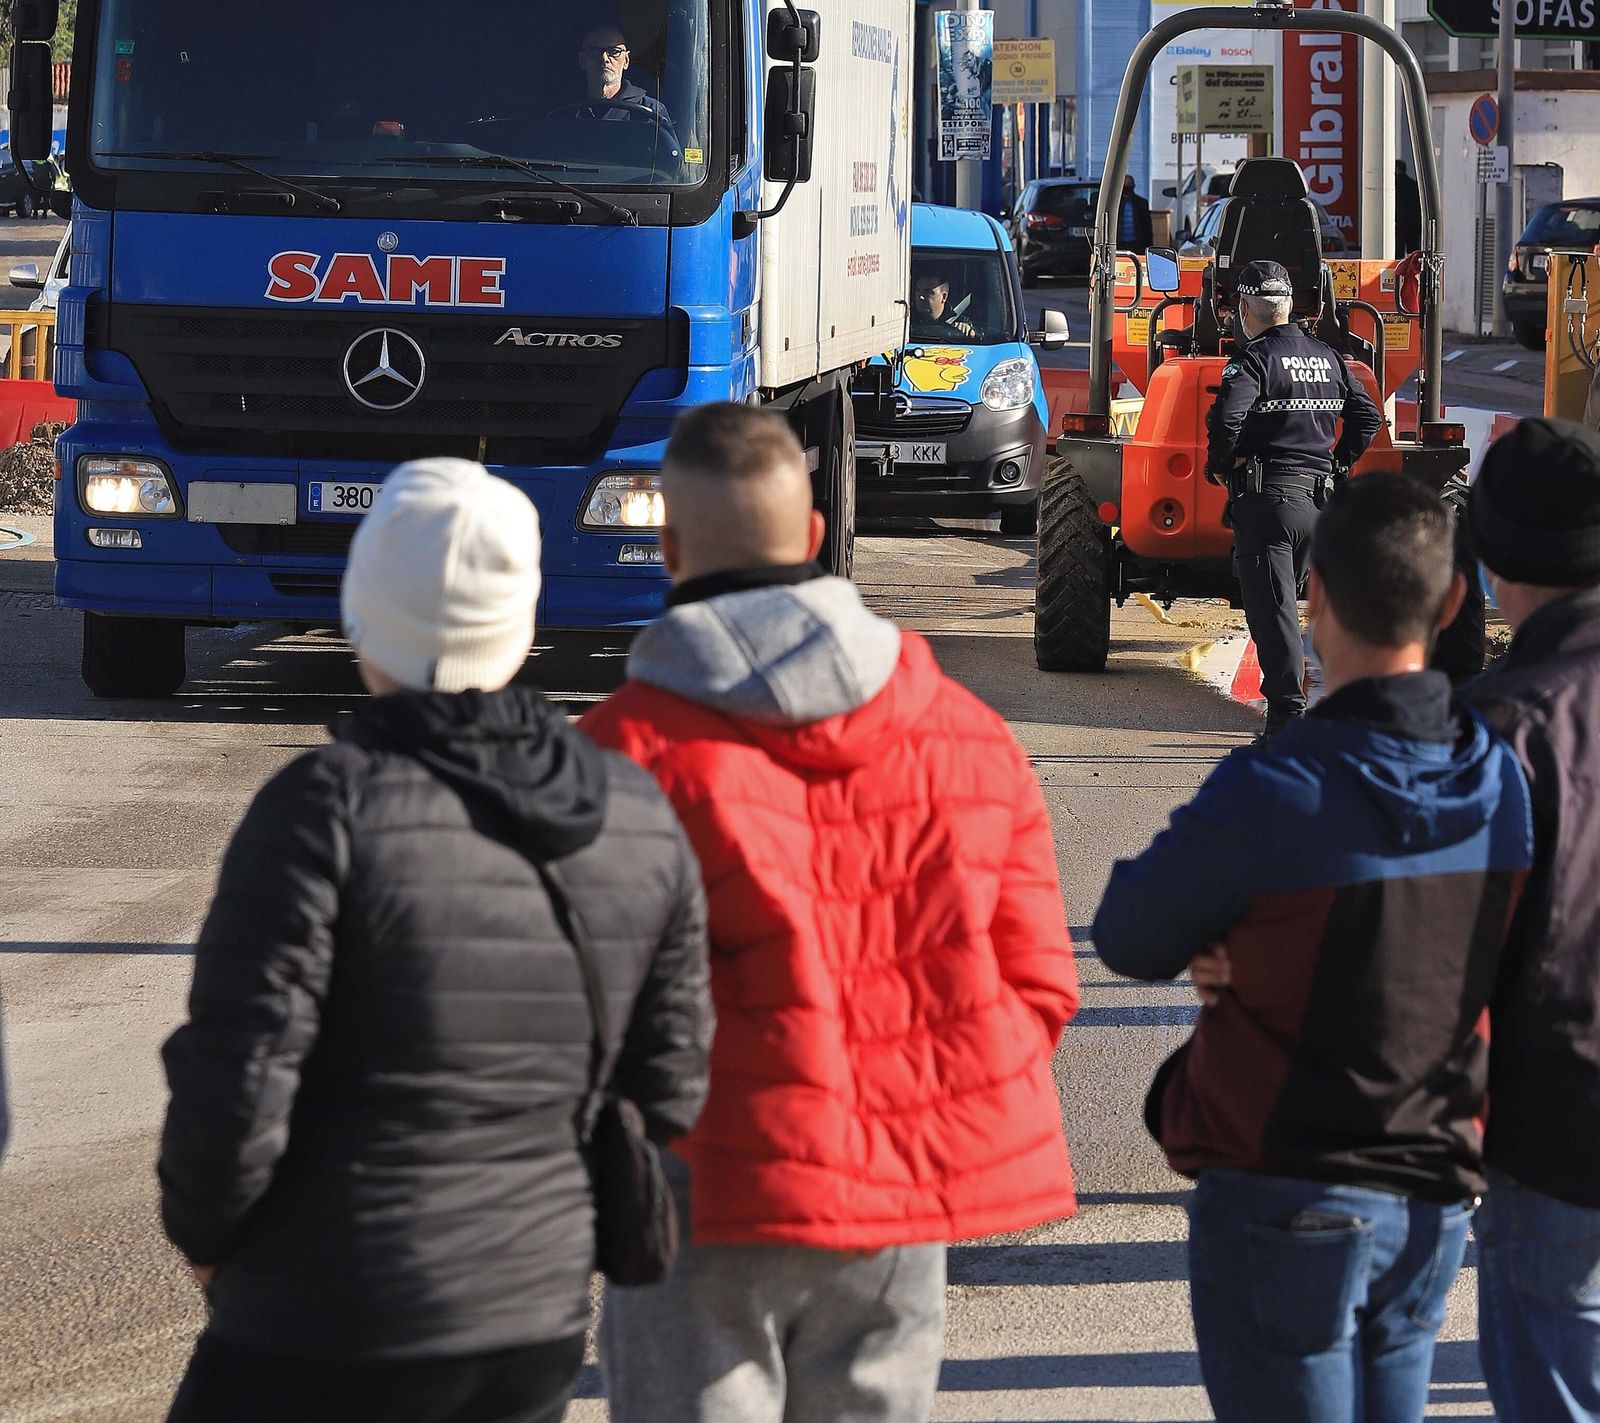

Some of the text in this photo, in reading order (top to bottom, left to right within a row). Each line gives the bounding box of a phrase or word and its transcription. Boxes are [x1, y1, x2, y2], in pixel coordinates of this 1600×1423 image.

[1175, 45, 1253, 57] Balay BOSCH
[1205, 78, 1265, 88] del descanso
[943, 141, 954, 154] 14
[264, 250, 507, 308] SAME
[1281, 356, 1332, 370] POLICIA
[1290, 369, 1331, 383] LOCAL
[912, 445, 941, 461] KKK
[333, 485, 383, 509] 380
